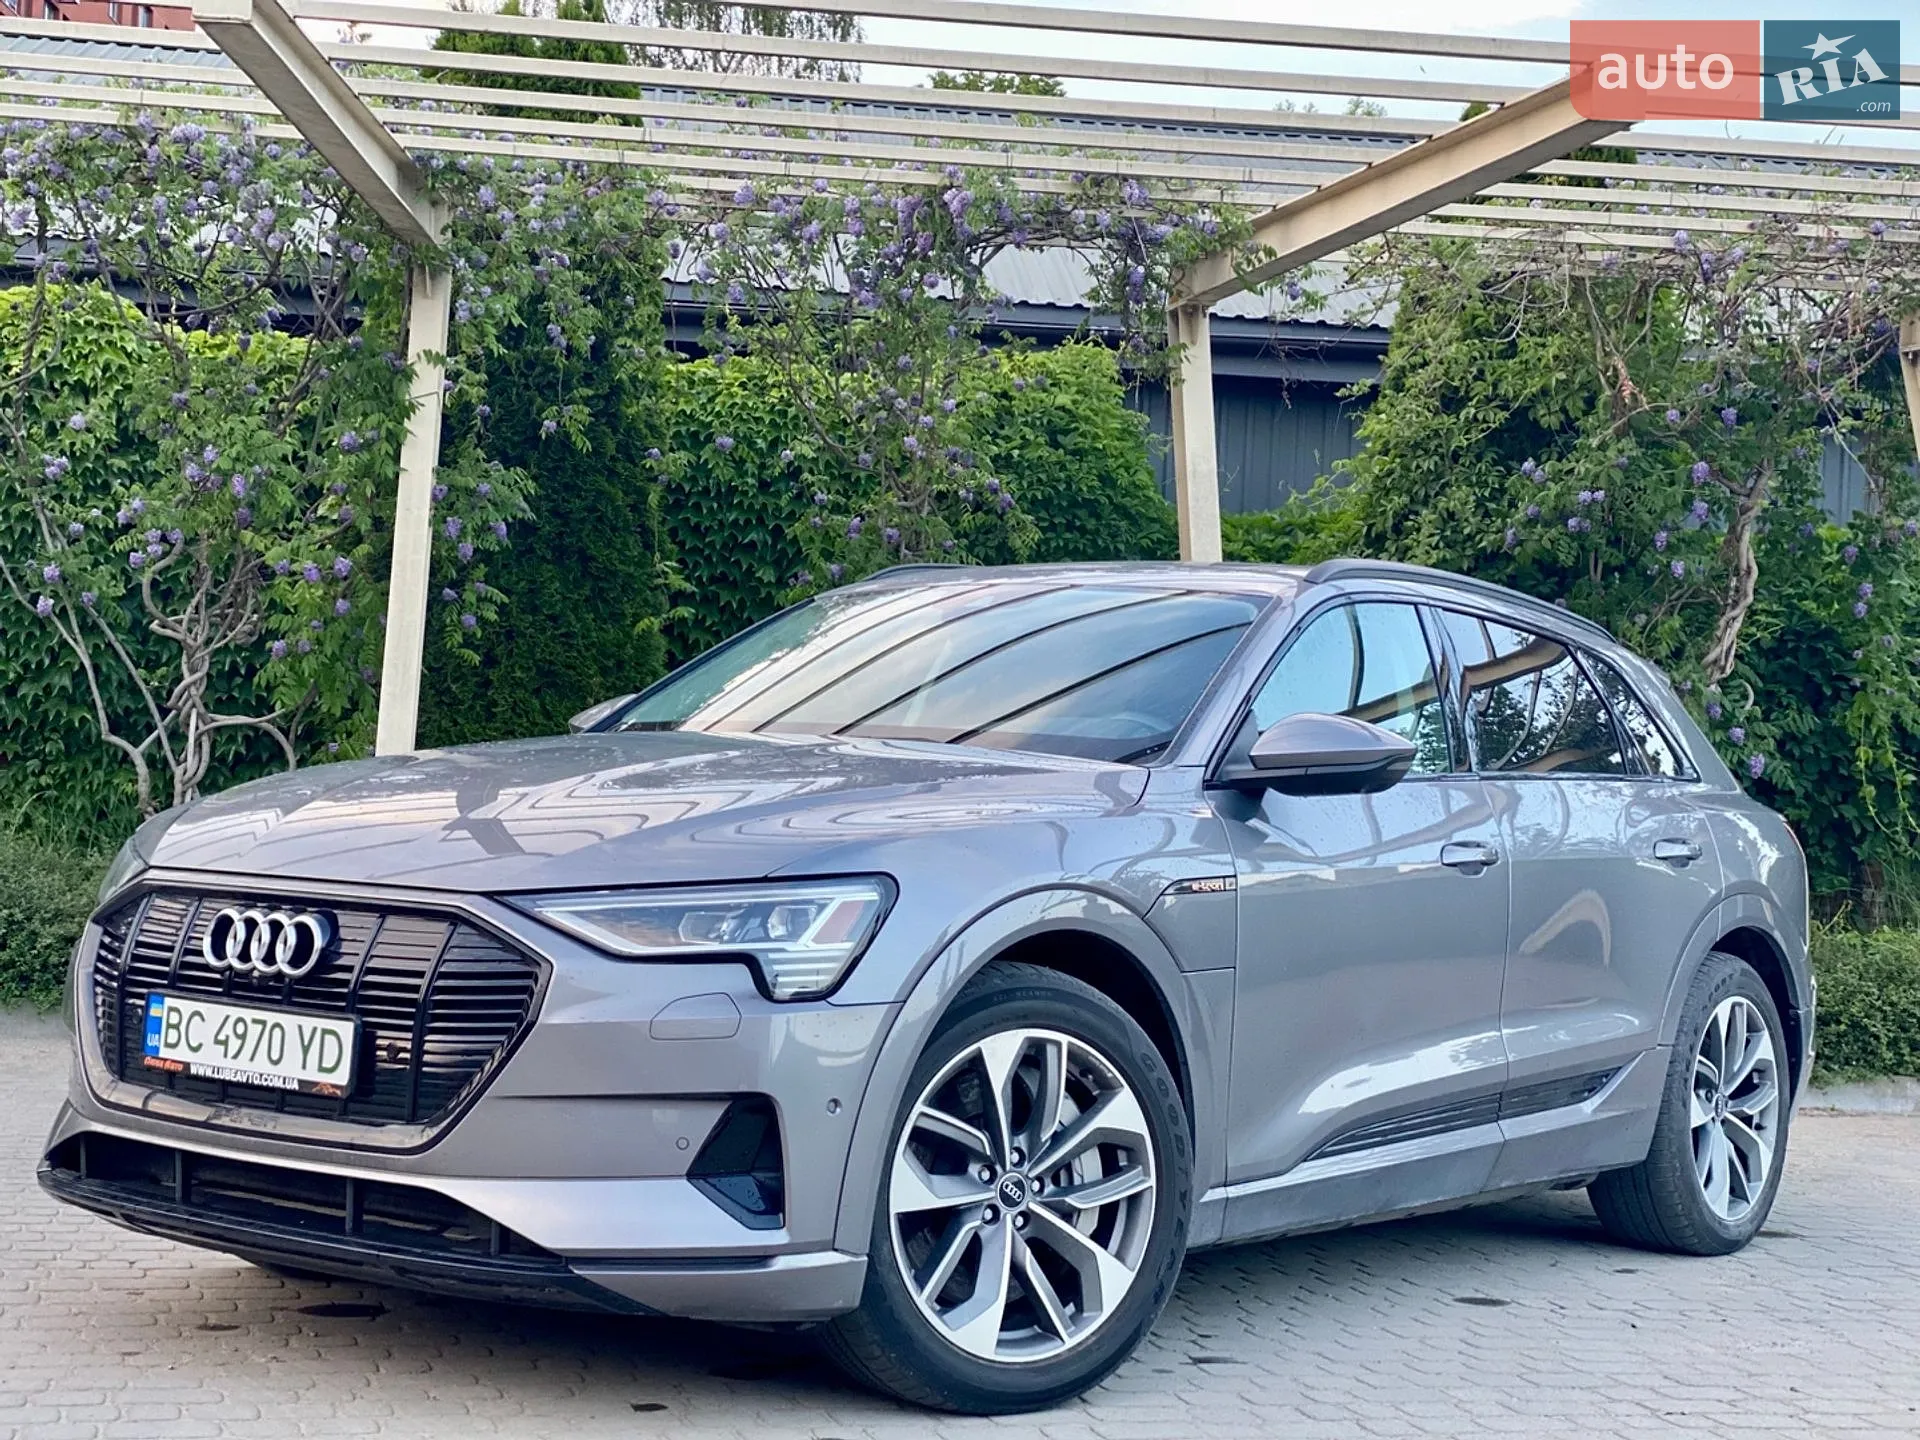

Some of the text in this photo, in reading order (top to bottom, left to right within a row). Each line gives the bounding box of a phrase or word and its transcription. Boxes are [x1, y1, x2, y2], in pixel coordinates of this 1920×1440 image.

[147, 1033, 160, 1048] UA
[163, 1006, 343, 1074] BC 4970 YD
